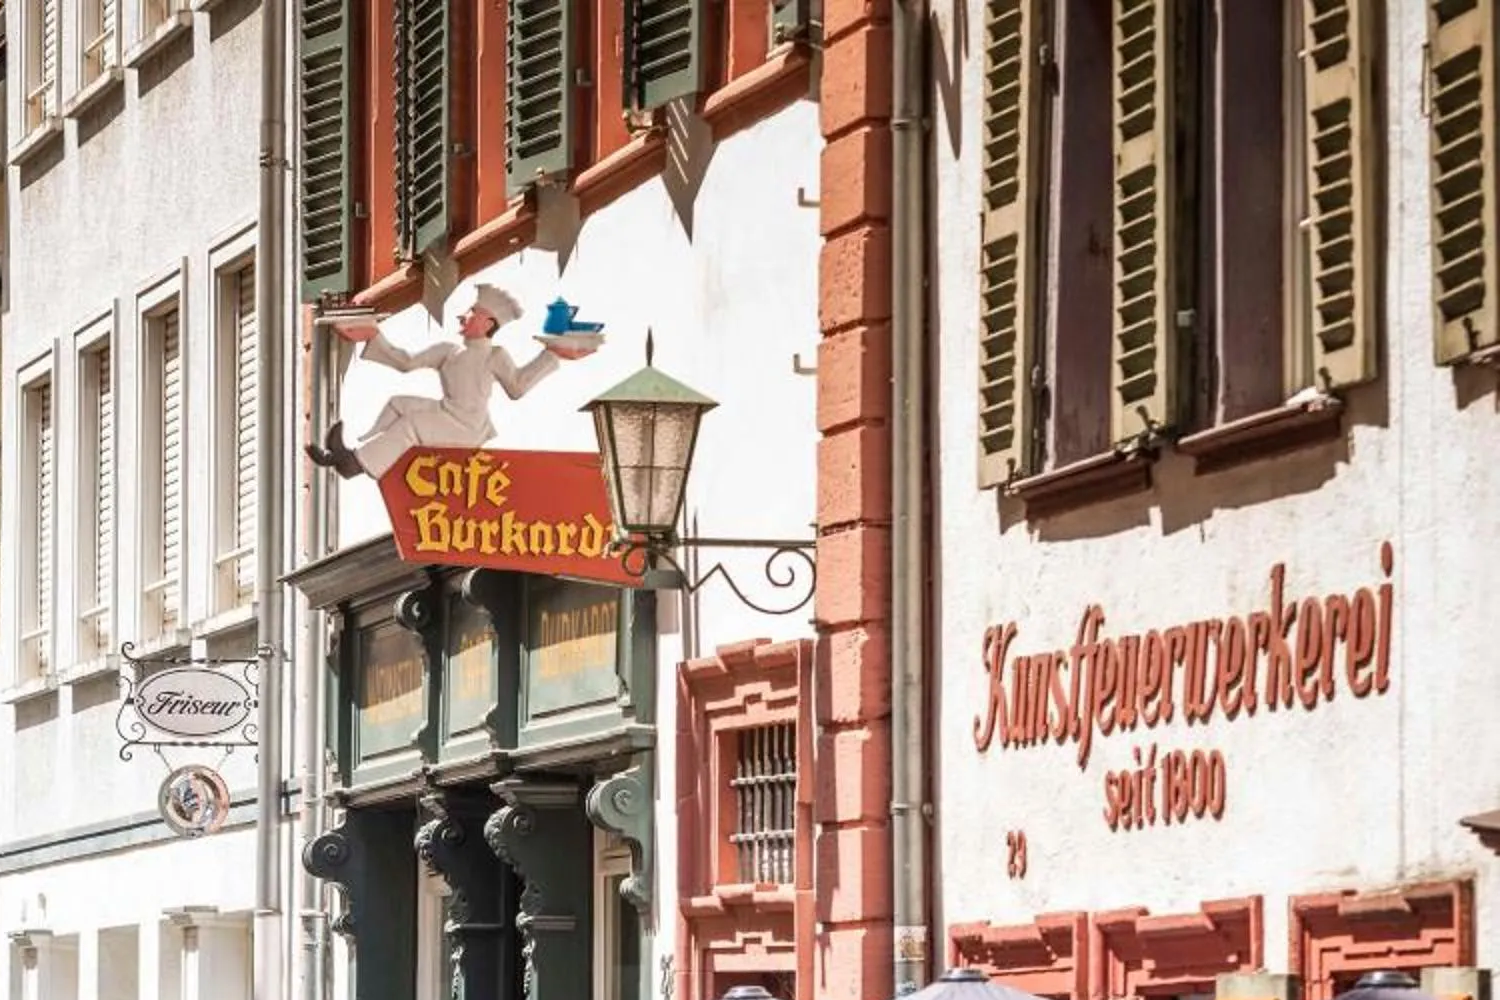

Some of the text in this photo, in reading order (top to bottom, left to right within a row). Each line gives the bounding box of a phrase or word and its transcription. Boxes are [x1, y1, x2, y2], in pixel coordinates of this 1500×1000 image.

[405, 451, 510, 509] Café
[973, 541, 1396, 772] Kunstfeuerwerkerei
[147, 690, 241, 716] Friseur
[1103, 742, 1227, 832] seit 1800
